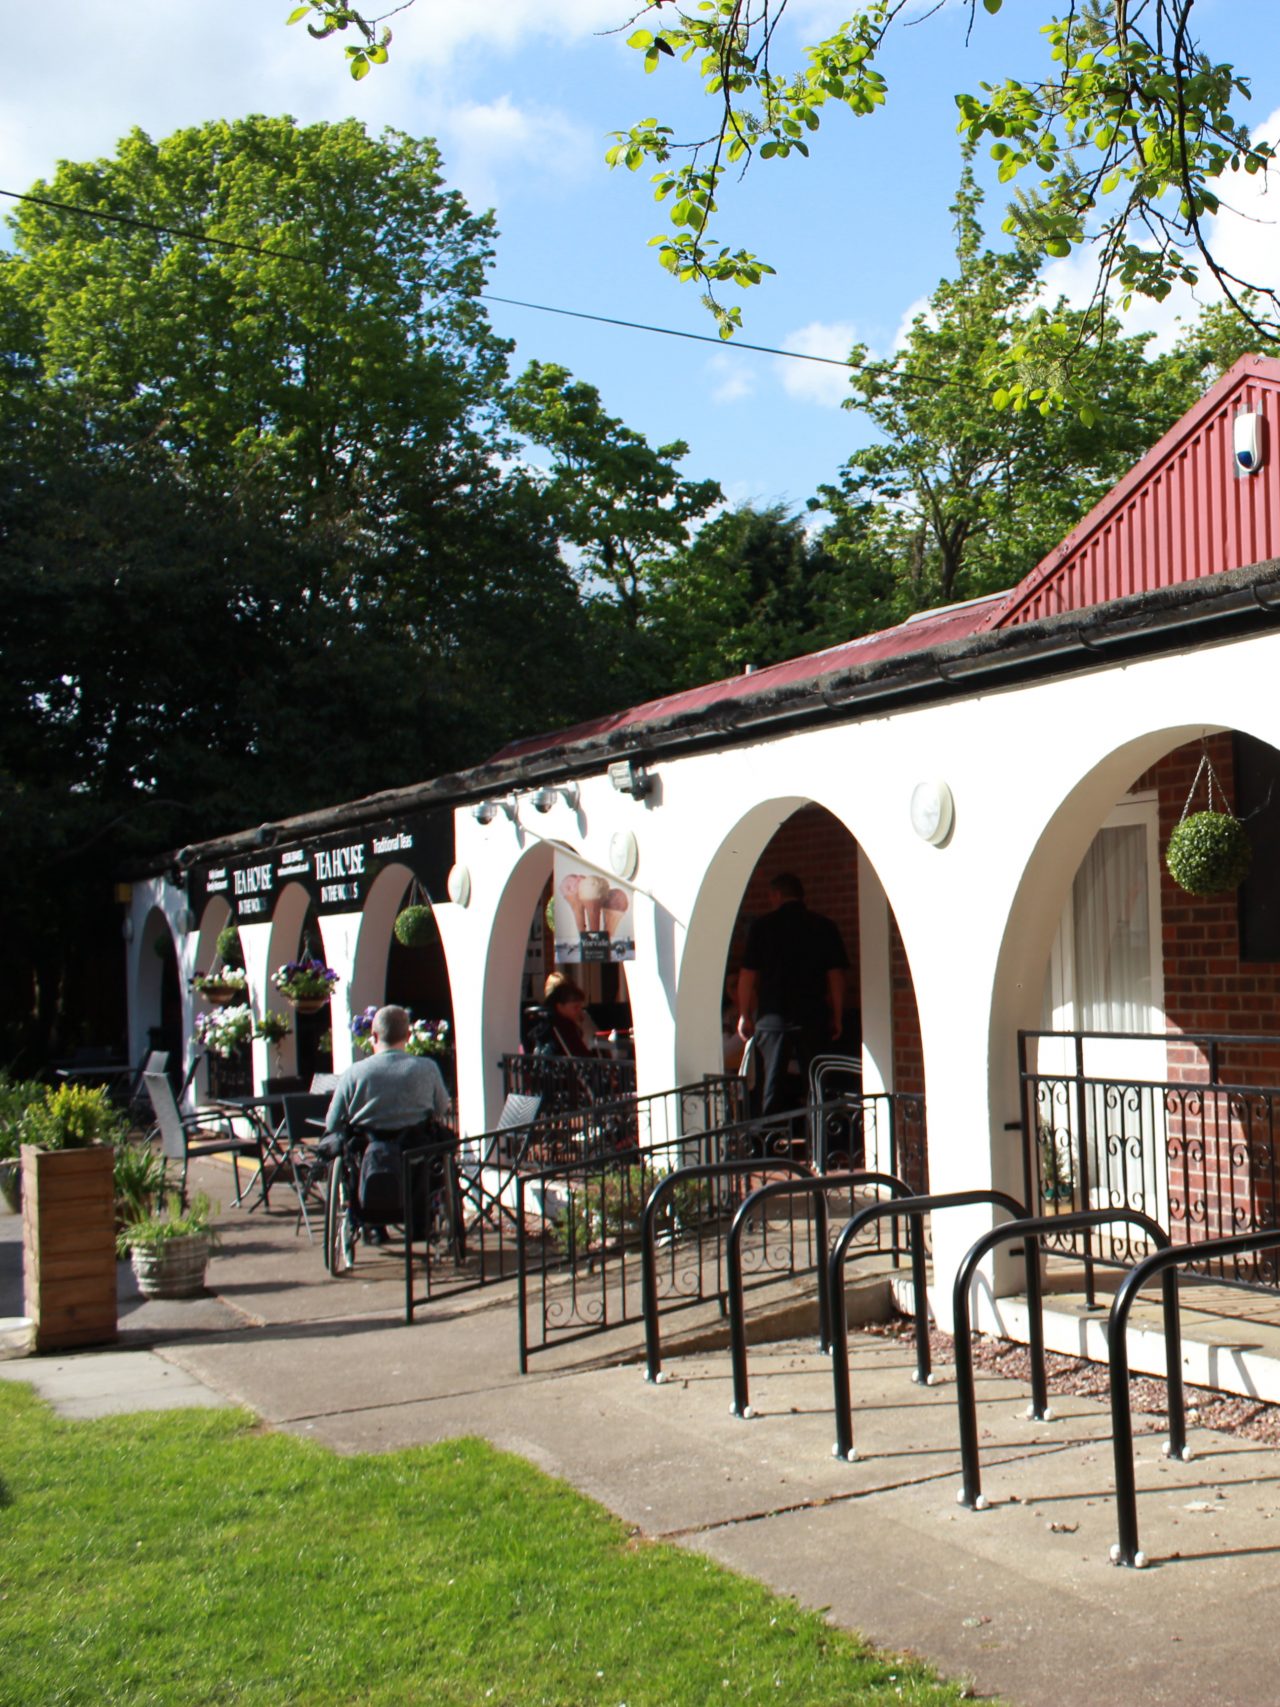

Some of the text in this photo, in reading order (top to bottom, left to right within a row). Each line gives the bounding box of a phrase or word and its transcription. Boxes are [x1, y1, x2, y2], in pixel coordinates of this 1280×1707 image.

[372, 832, 412, 854] Traditional Teas
[314, 851, 332, 880] TEA
[332, 843, 365, 877] HOUSE
[233, 869, 247, 895] TEA
[247, 863, 273, 892] HOUSE
